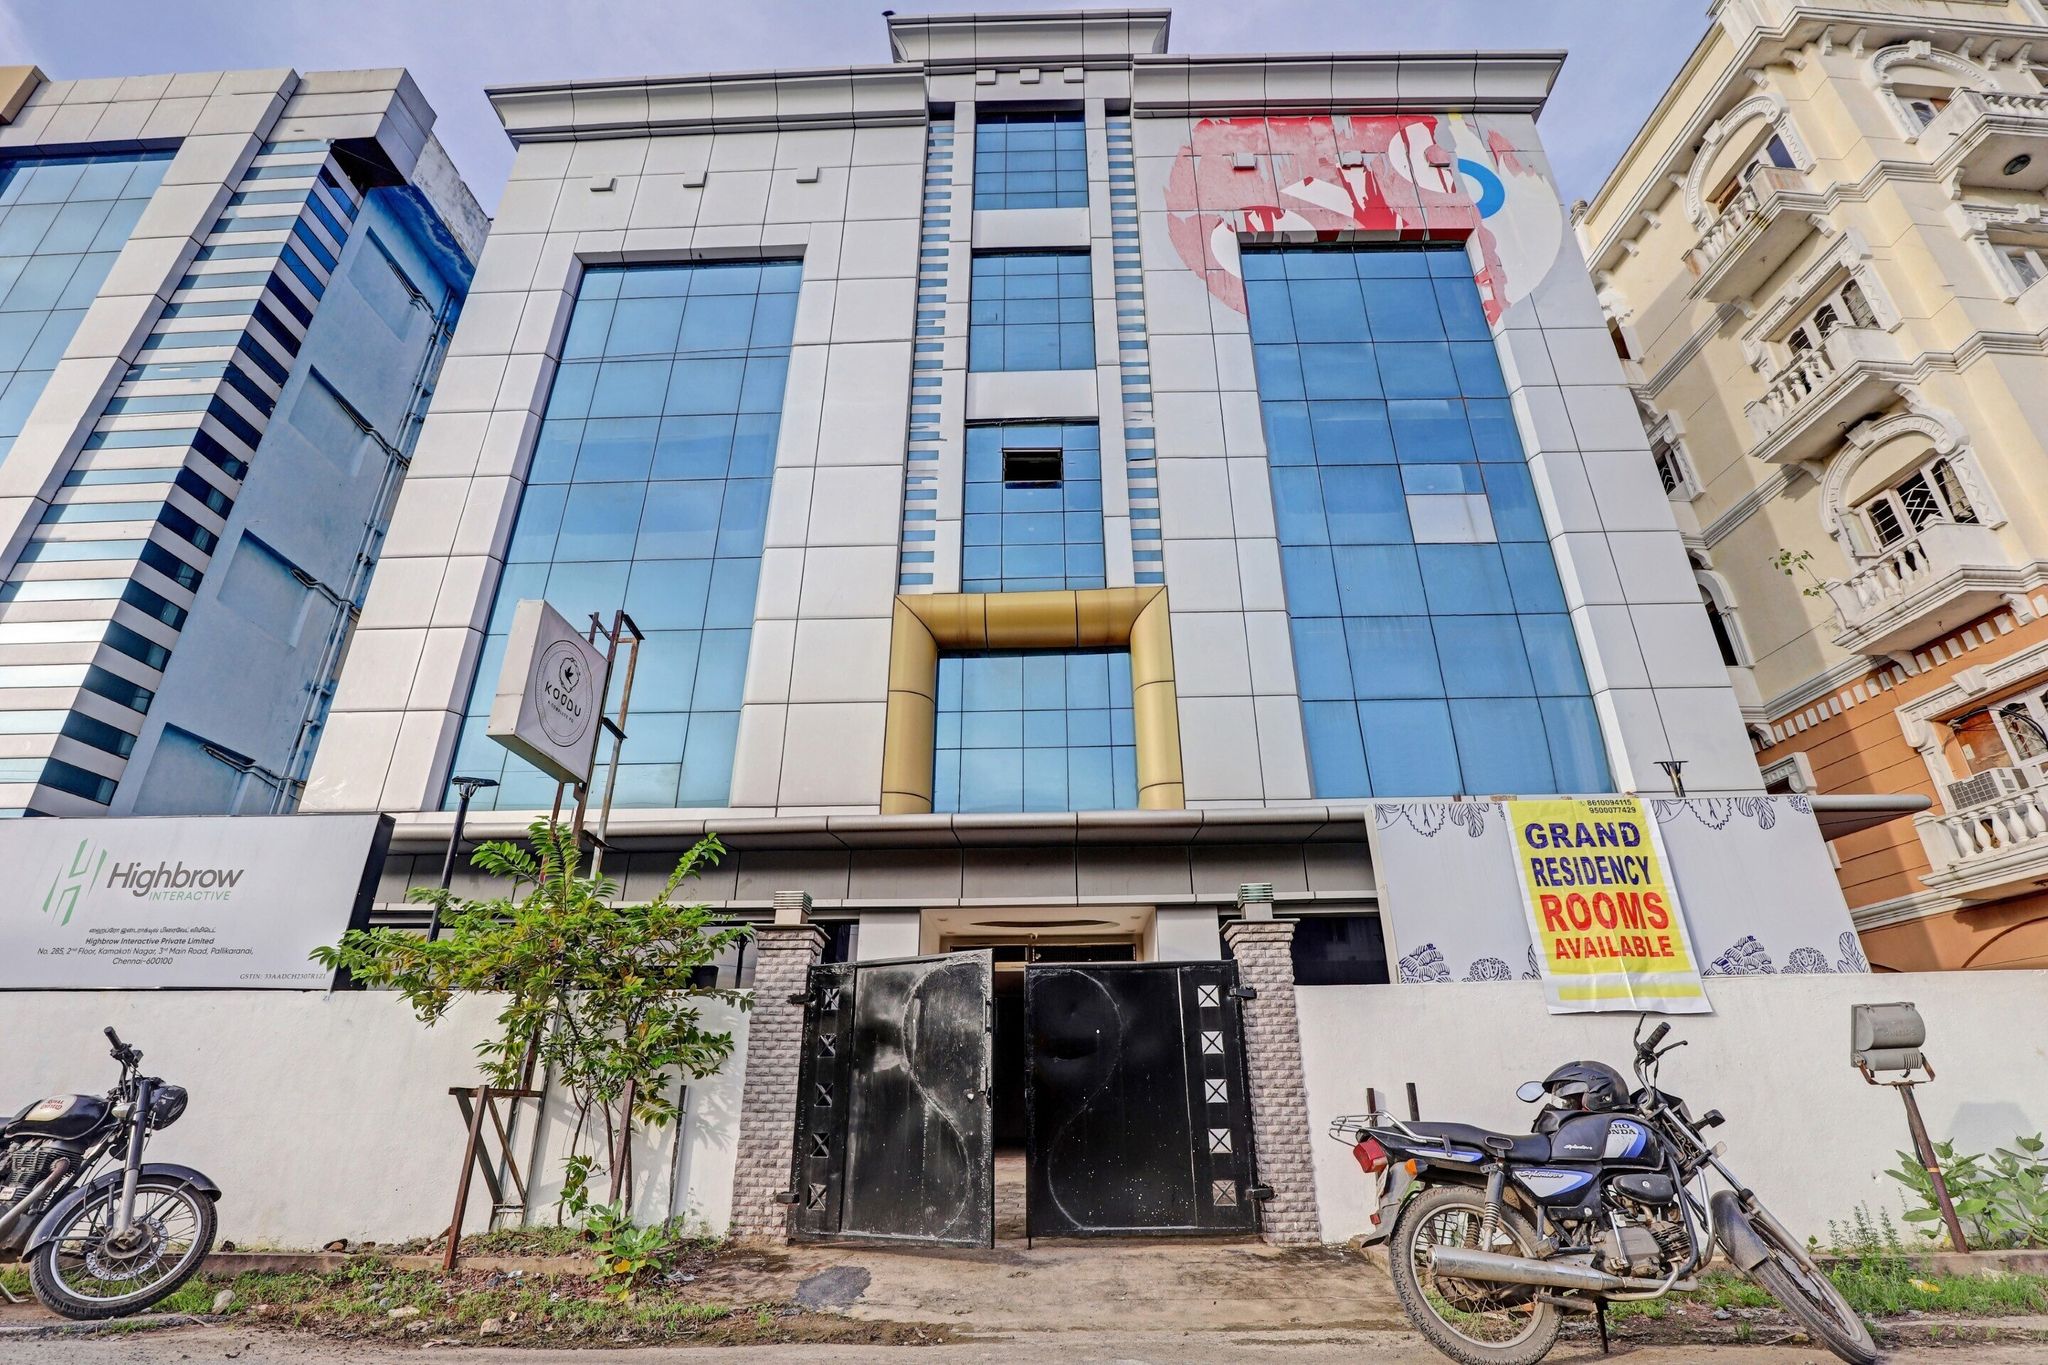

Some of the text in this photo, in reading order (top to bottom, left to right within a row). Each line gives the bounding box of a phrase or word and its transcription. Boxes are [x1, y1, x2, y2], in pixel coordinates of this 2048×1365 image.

[545, 681, 581, 717] KOODU
[1589, 806, 1637, 814] 9500077429
[1525, 822, 1641, 849] GRAND
[106, 861, 245, 898] Highbrow
[1530, 856, 1652, 887] RESIDENCY
[148, 890, 232, 901] INTERACTIVE
[1539, 892, 1669, 932] ROOMS
[78, 948, 96, 956] Floor,
[133, 948, 157, 956] Nagar,
[85, 938, 120, 946] Highbrow
[1555, 936, 1675, 960] AVAILABLE
[112, 957, 173, 965] Chennai-600100
